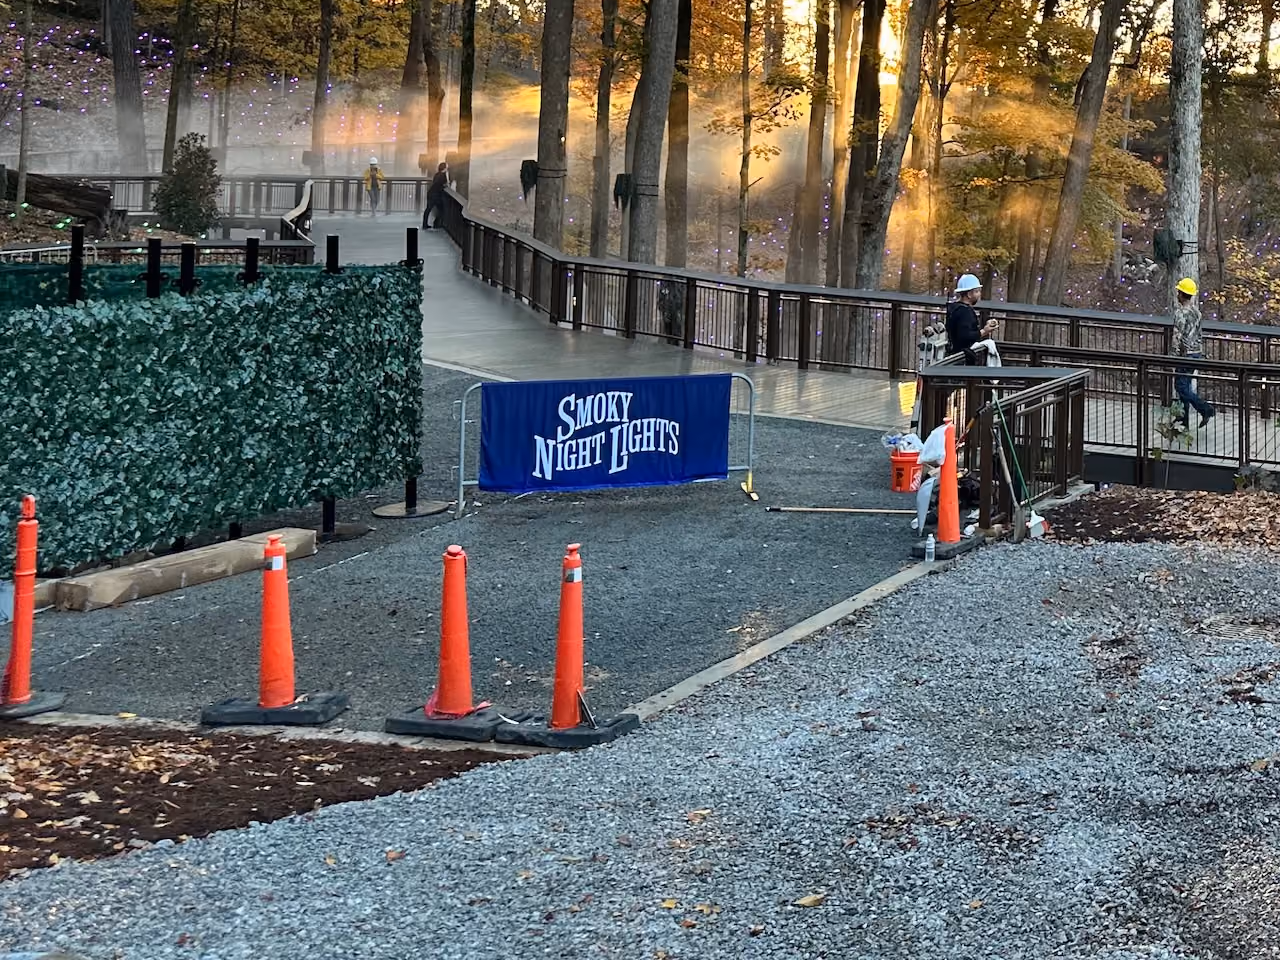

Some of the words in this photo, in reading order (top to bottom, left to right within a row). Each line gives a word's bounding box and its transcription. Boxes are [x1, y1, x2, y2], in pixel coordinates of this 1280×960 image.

[558, 391, 633, 442] SMOKY
[532, 432, 606, 480] NIGHT
[608, 418, 680, 474] LIGHTS
